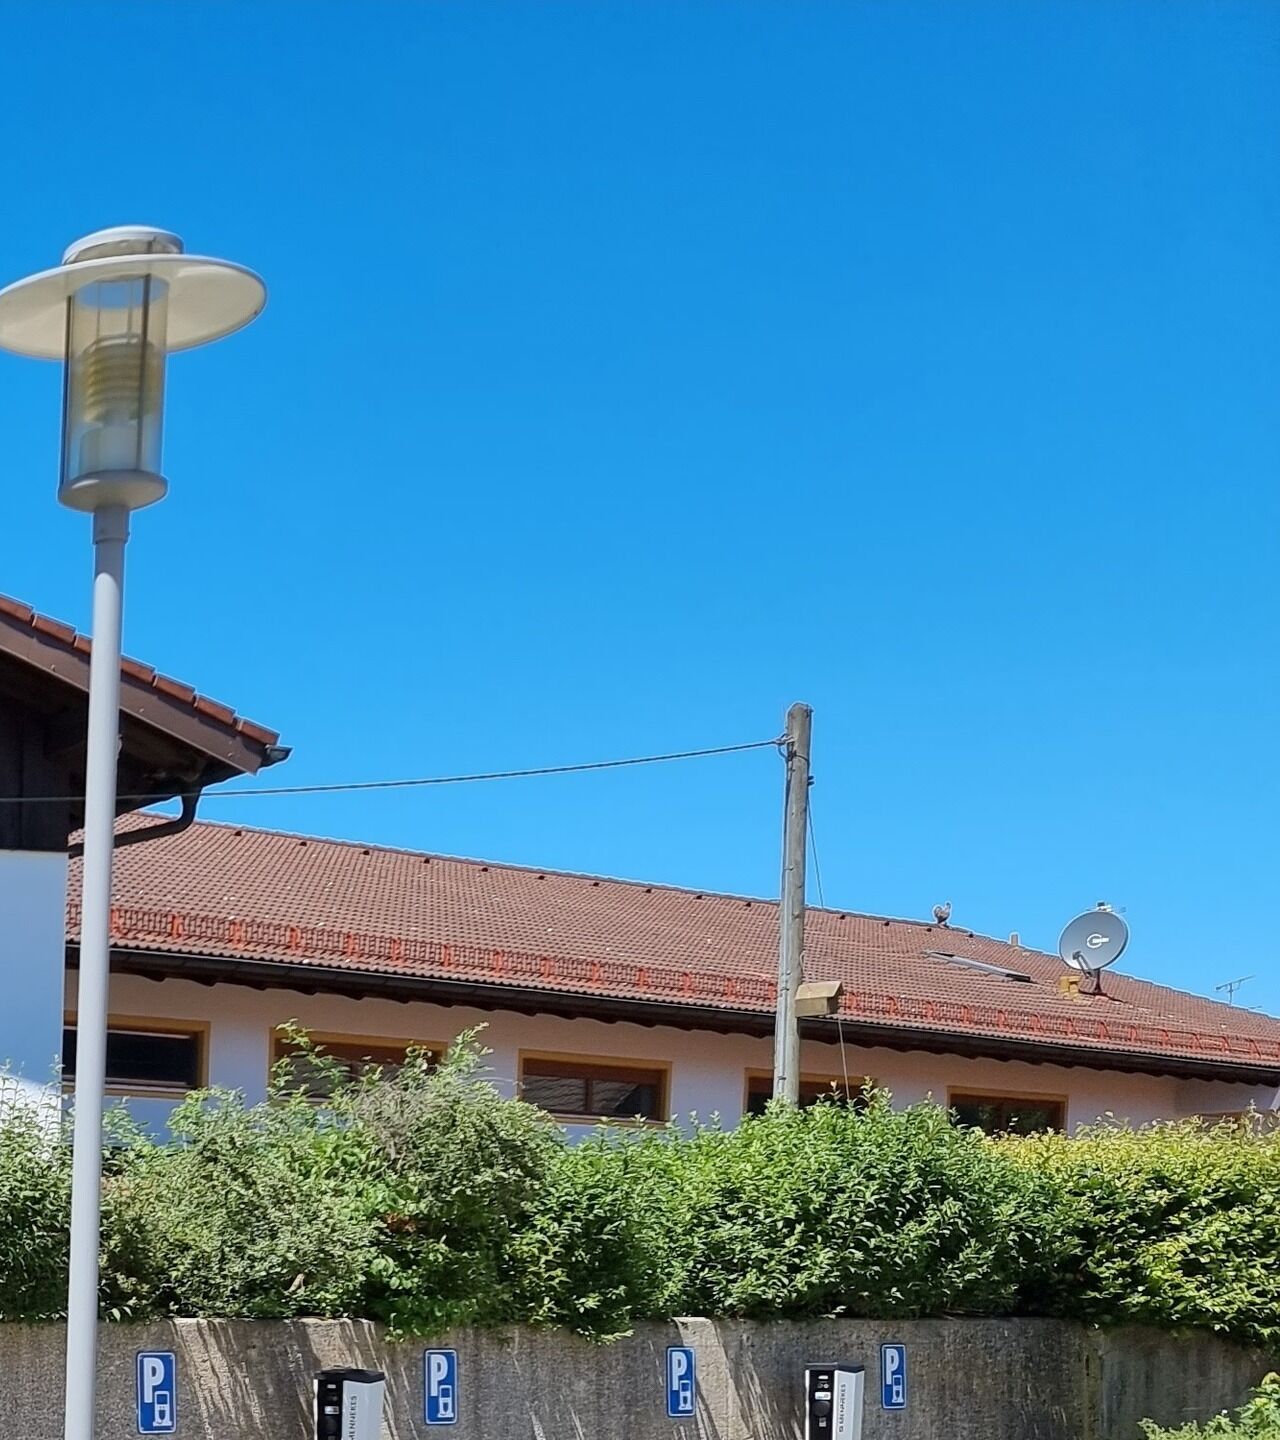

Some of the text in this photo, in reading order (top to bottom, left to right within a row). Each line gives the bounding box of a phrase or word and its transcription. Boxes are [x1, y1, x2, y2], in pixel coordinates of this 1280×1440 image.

[142, 1357, 165, 1404] P
[430, 1353, 448, 1397] P
[671, 1351, 688, 1391] P
[885, 1348, 900, 1385] P
